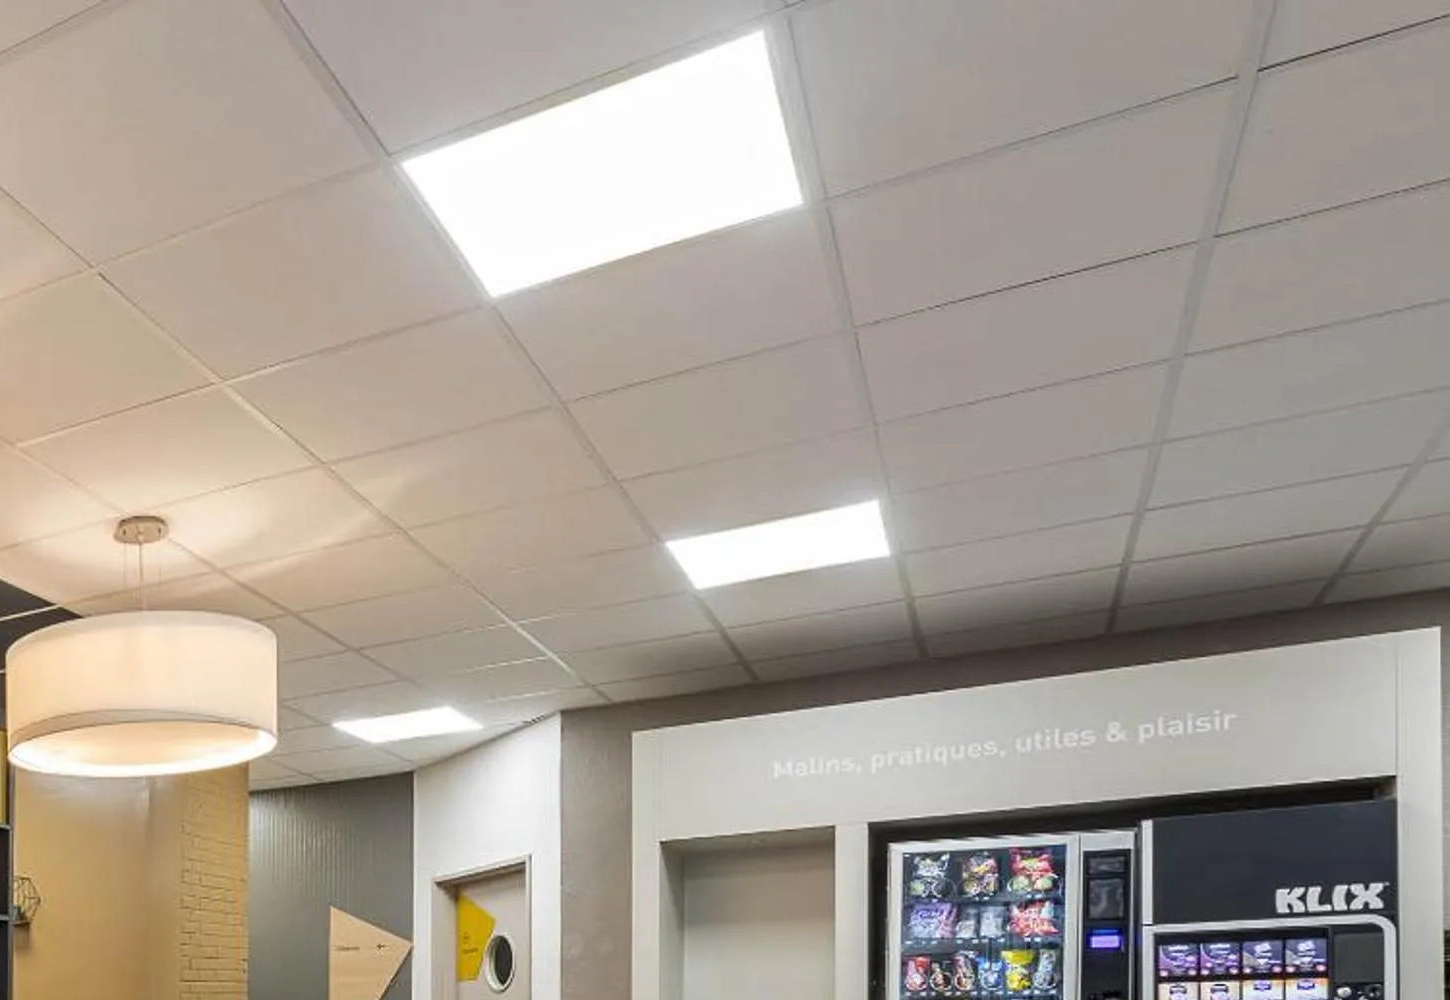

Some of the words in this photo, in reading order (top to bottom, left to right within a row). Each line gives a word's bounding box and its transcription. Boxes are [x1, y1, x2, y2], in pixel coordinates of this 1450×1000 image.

[771, 757, 862, 779] Malins,
[870, 740, 1006, 774] pratiques,
[1015, 727, 1096, 753] utiles
[1105, 721, 1127, 743] &
[1138, 709, 1238, 744] plaisir
[1275, 882, 1385, 914] KLIX
